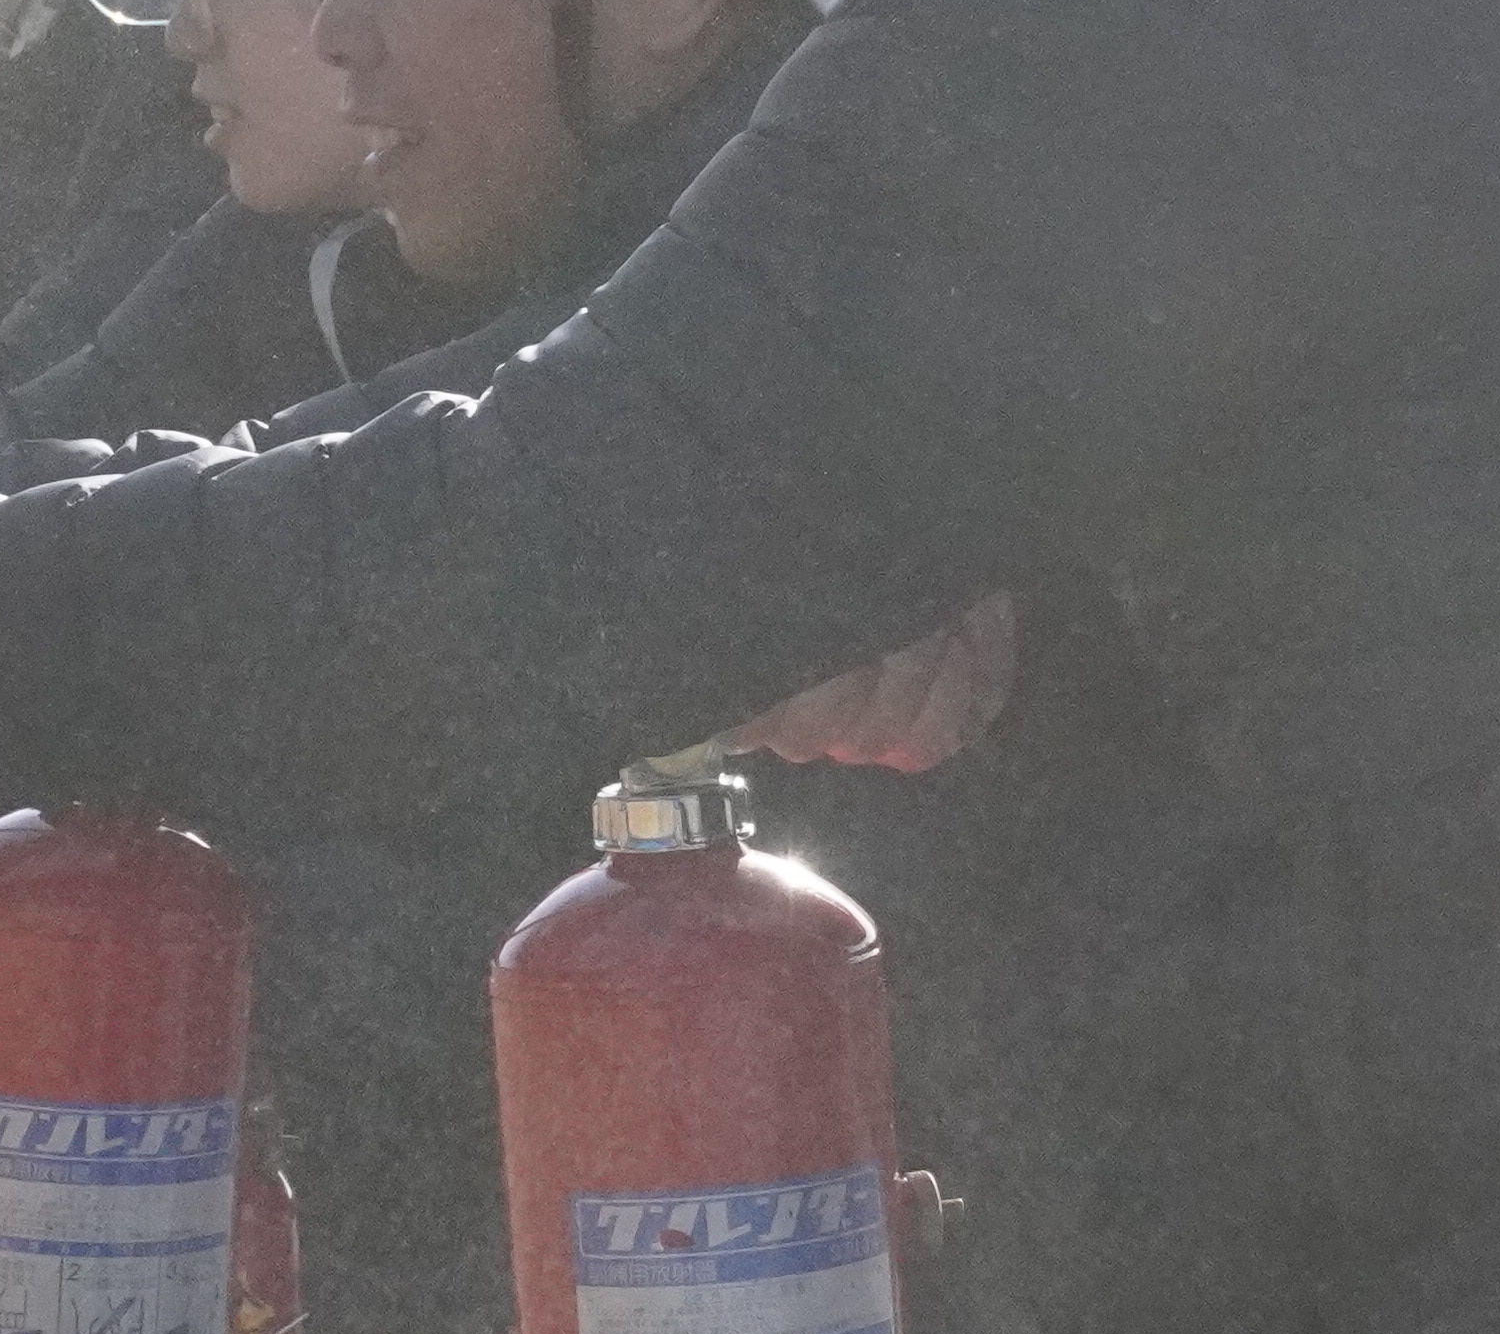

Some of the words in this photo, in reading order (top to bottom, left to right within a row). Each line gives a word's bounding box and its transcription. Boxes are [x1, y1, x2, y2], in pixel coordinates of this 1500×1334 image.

[597, 1183, 870, 1252] クンレンター
